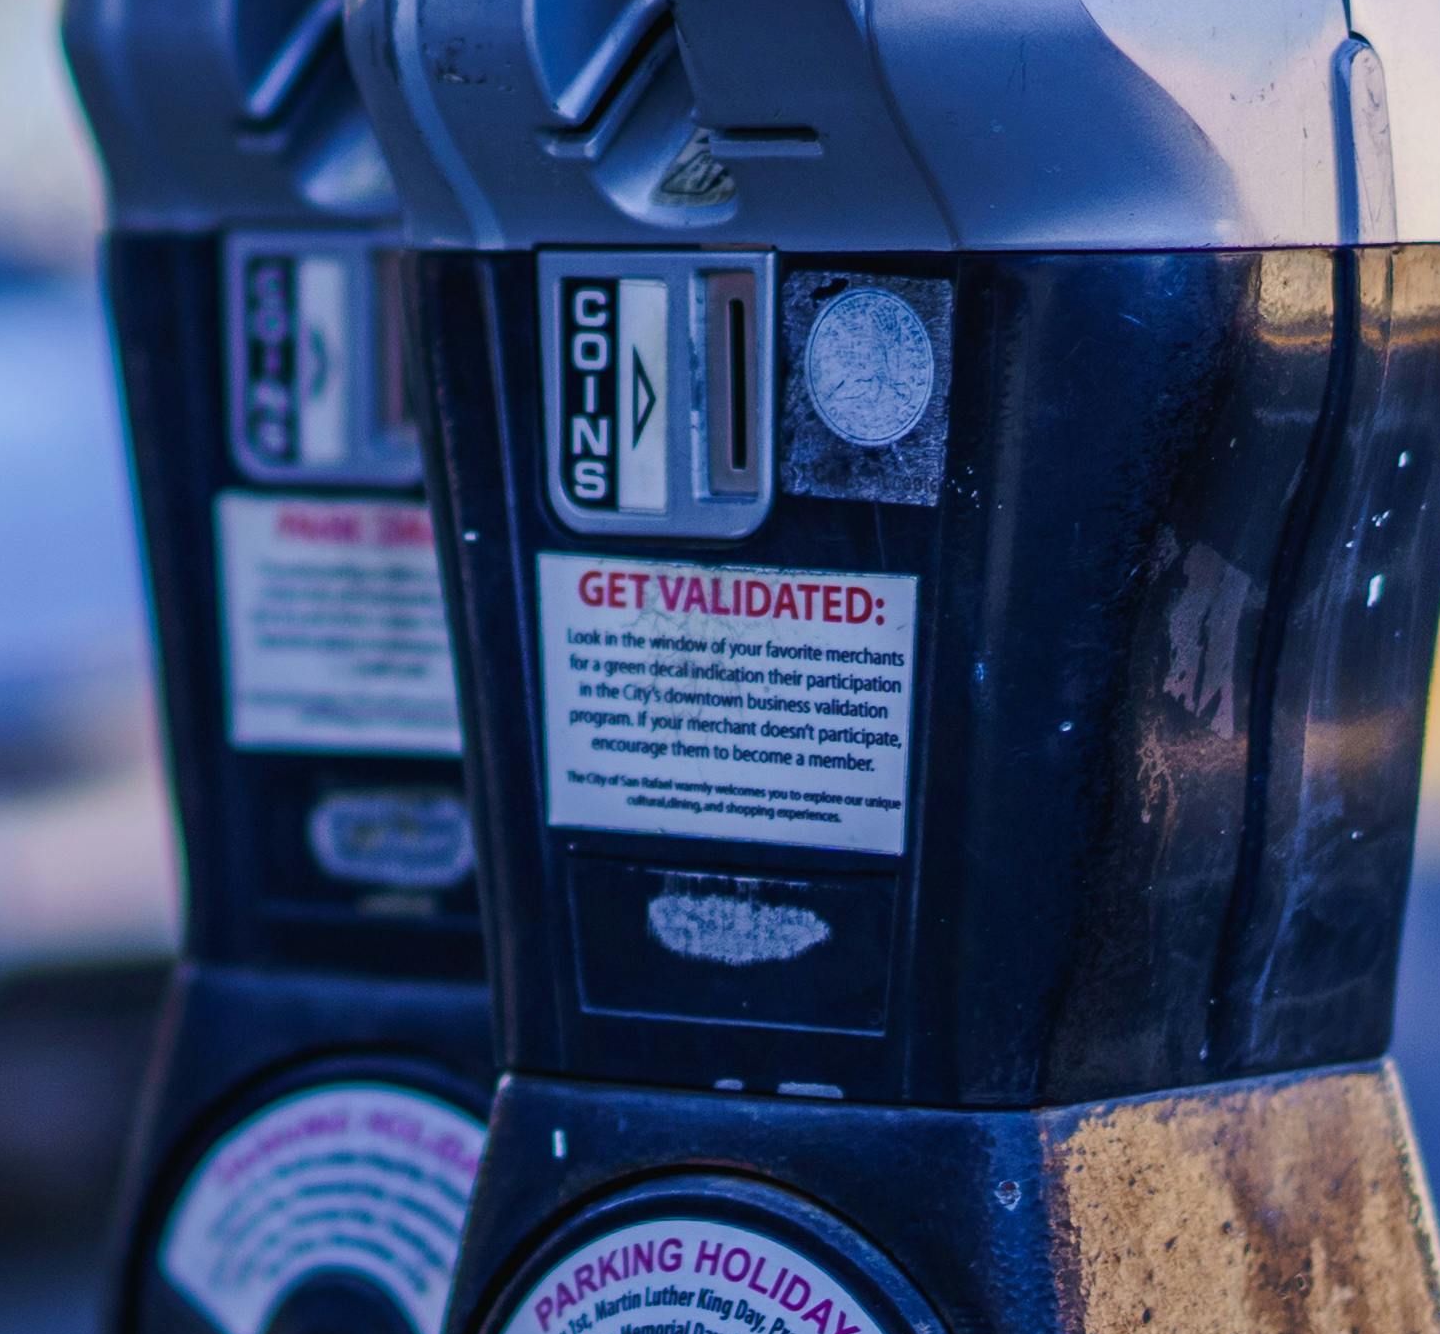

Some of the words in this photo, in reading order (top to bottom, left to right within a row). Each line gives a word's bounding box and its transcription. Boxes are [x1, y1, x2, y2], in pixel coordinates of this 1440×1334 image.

[573, 289, 609, 500] COINS
[579, 570, 650, 609] GET
[657, 575, 885, 626] VALIDATED:
[568, 628, 600, 646] Look
[605, 631, 618, 647] in
[622, 631, 646, 649] the
[650, 635, 708, 653] window
[711, 638, 727, 655] of
[729, 642, 762, 659] your
[766, 640, 823, 662] favorite
[826, 647, 905, 667] merchants
[570, 653, 590, 671] for
[593, 658, 601, 671] a
[605, 658, 646, 677] green
[650, 660, 688, 678] decal
[692, 663, 764, 683] indication
[768, 668, 802, 686] their
[807, 671, 902, 694] participation
[580, 680, 593, 698] in
[596, 682, 620, 700] the
[664, 687, 743, 708] downtown
[747, 693, 811, 714] business
[814, 699, 888, 719] validation
[570, 709, 634, 729] program.
[638, 711, 648, 727] If
[650, 715, 684, 733] your
[687, 717, 756, 736] merchant
[760, 720, 815, 741] doesn't
[818, 727, 902, 749] participate,
[591, 737, 668, 759] encourage
[672, 740, 710, 759] them
[714, 744, 730, 761] to
[733, 745, 793, 765] become
[796, 753, 805, 766] a
[809, 753, 875, 772] member.
[567, 770, 585, 784] The
[586, 772, 607, 787] City
[608, 773, 620, 786] of
[621, 775, 639, 788] San
[641, 777, 673, 790] Rafael
[675, 781, 713, 796] warmly
[714, 783, 766, 799] welcomes
[768, 787, 788, 801] you
[790, 789, 801, 801] to
[803, 791, 843, 805] explore
[844, 794, 863, 806] our
[865, 798, 901, 812] unique
[726, 803, 775, 820] shopping
[776, 809, 842, 824] experiences.
[534, 1238, 683, 1333] PARKING
[594, 1290, 642, 1321] Martin
[645, 1284, 695, 1307] Luther
[696, 1287, 734, 1321] King
[734, 1299, 766, 1334] Day,
